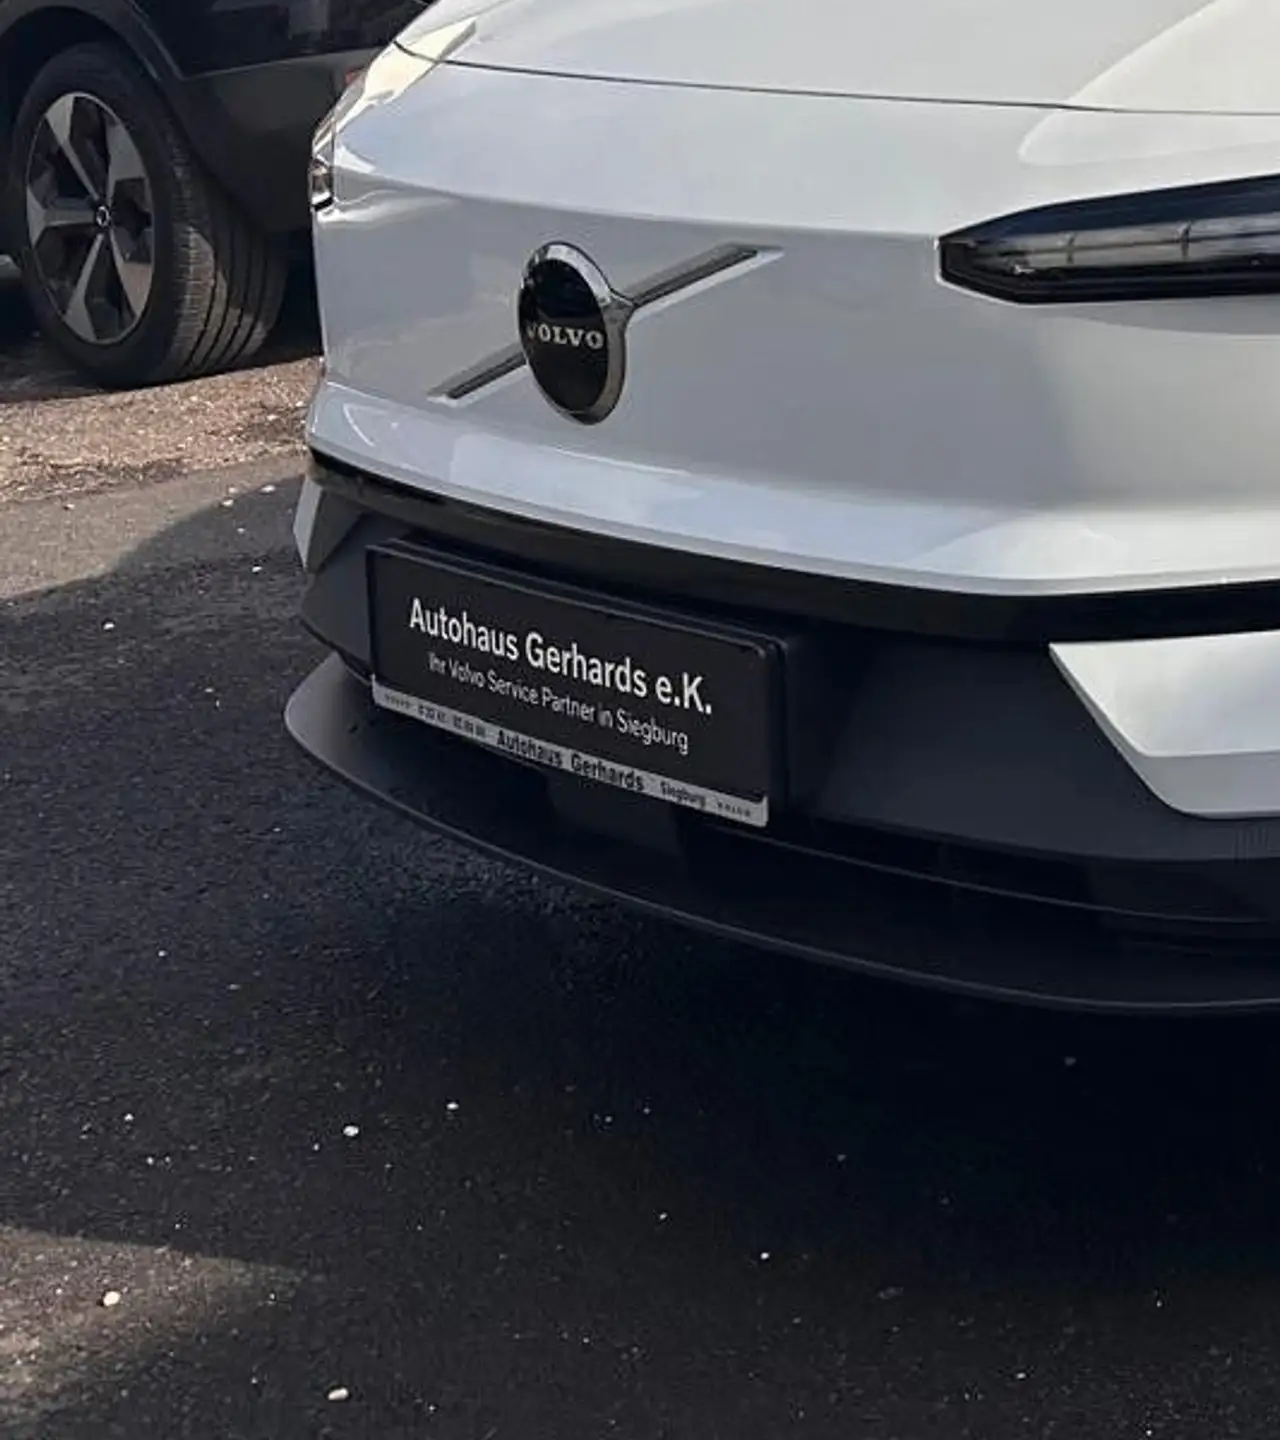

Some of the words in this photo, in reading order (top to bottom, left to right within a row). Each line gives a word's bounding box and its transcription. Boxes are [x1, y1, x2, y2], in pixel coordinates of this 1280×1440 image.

[525, 323, 605, 350] VOLVO
[410, 597, 519, 660] Autohaus
[525, 630, 648, 698] Gerhards
[655, 672, 712, 715] e.K.
[448, 657, 486, 688] Volvo
[487, 668, 539, 705] Service
[541, 686, 596, 723] Partner
[598, 701, 614, 729] in
[616, 707, 689, 756] Siegburg
[496, 728, 562, 767] Autohaus
[570, 752, 645, 793] Gerhards
